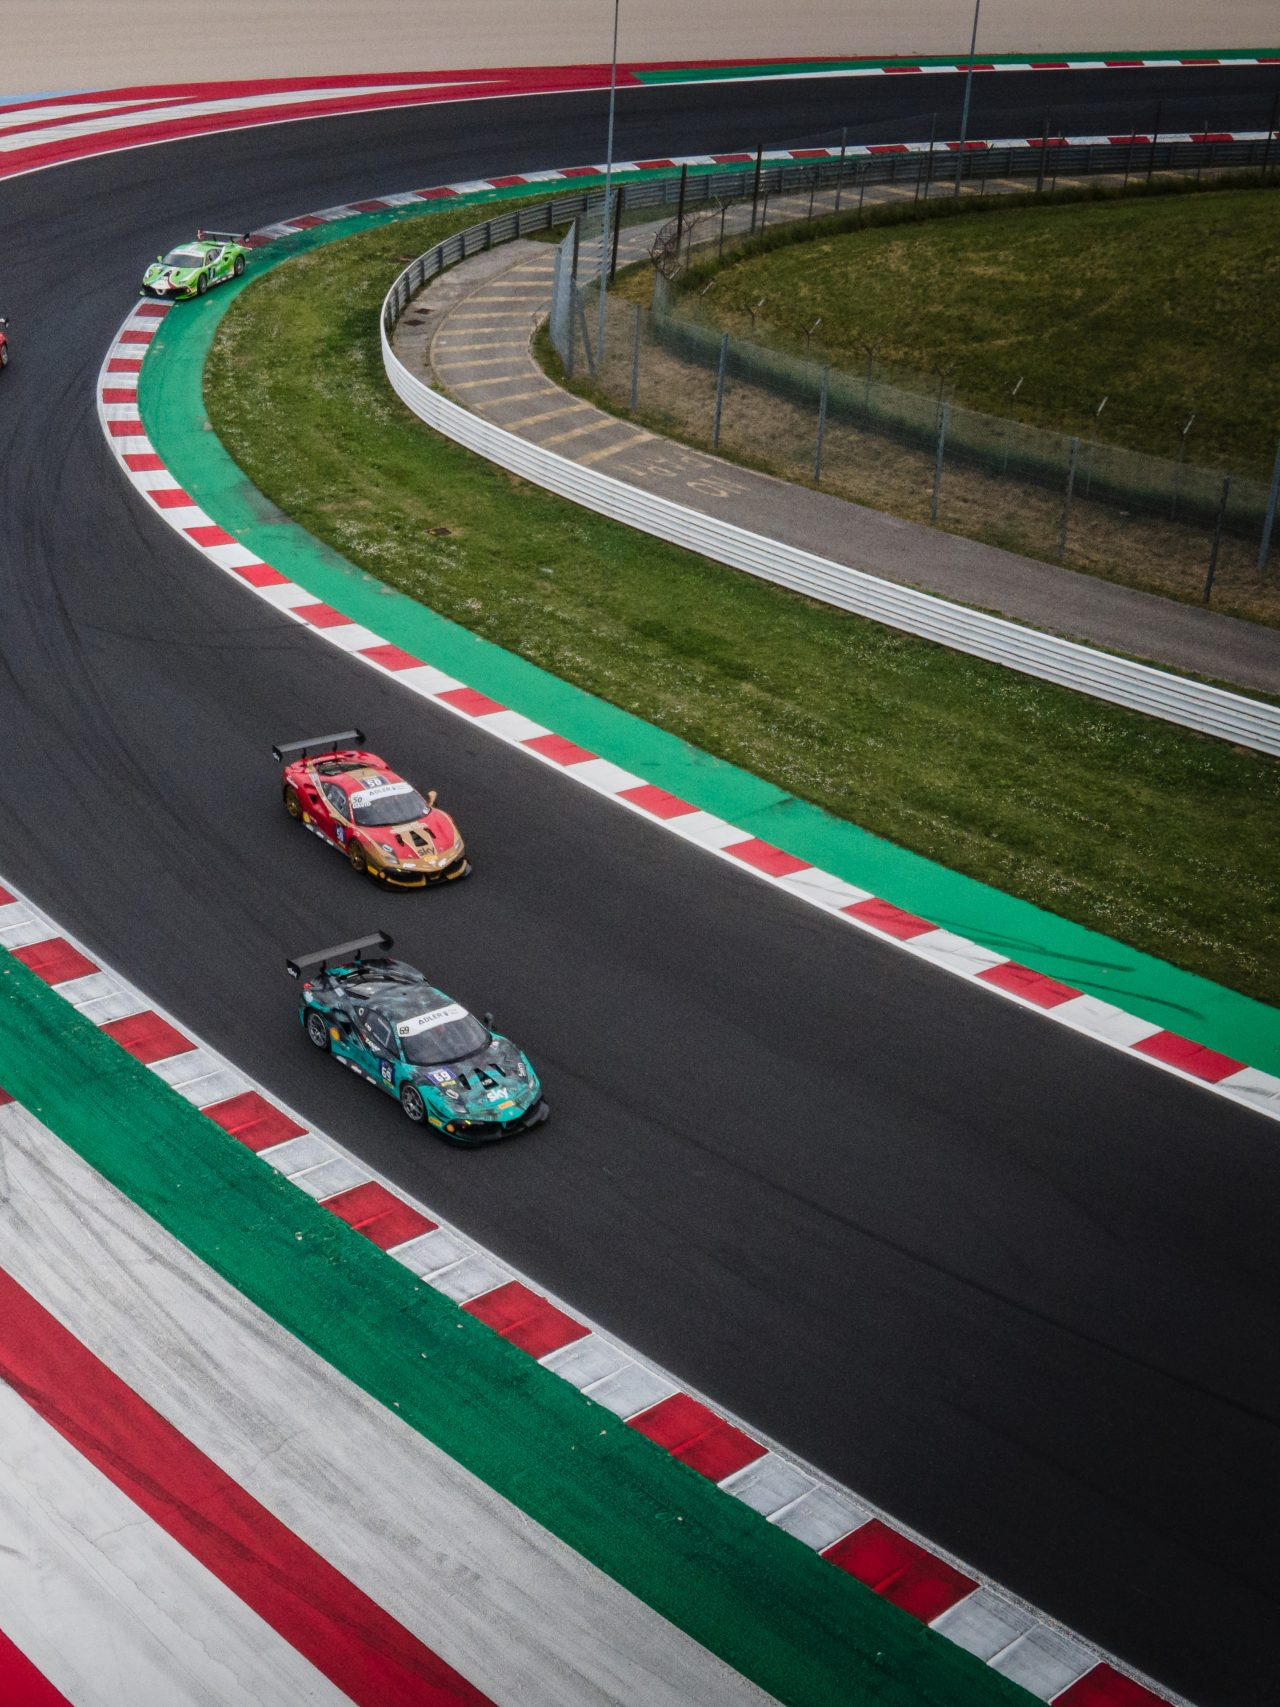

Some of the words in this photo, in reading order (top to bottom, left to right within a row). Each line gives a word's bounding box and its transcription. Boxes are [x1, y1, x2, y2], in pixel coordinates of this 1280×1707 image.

[419, 847, 435, 857] sky
[418, 1012, 445, 1025] ADLER
[399, 1026, 410, 1035] 69
[433, 1068, 452, 1082] 69
[486, 1087, 509, 1102] sky
